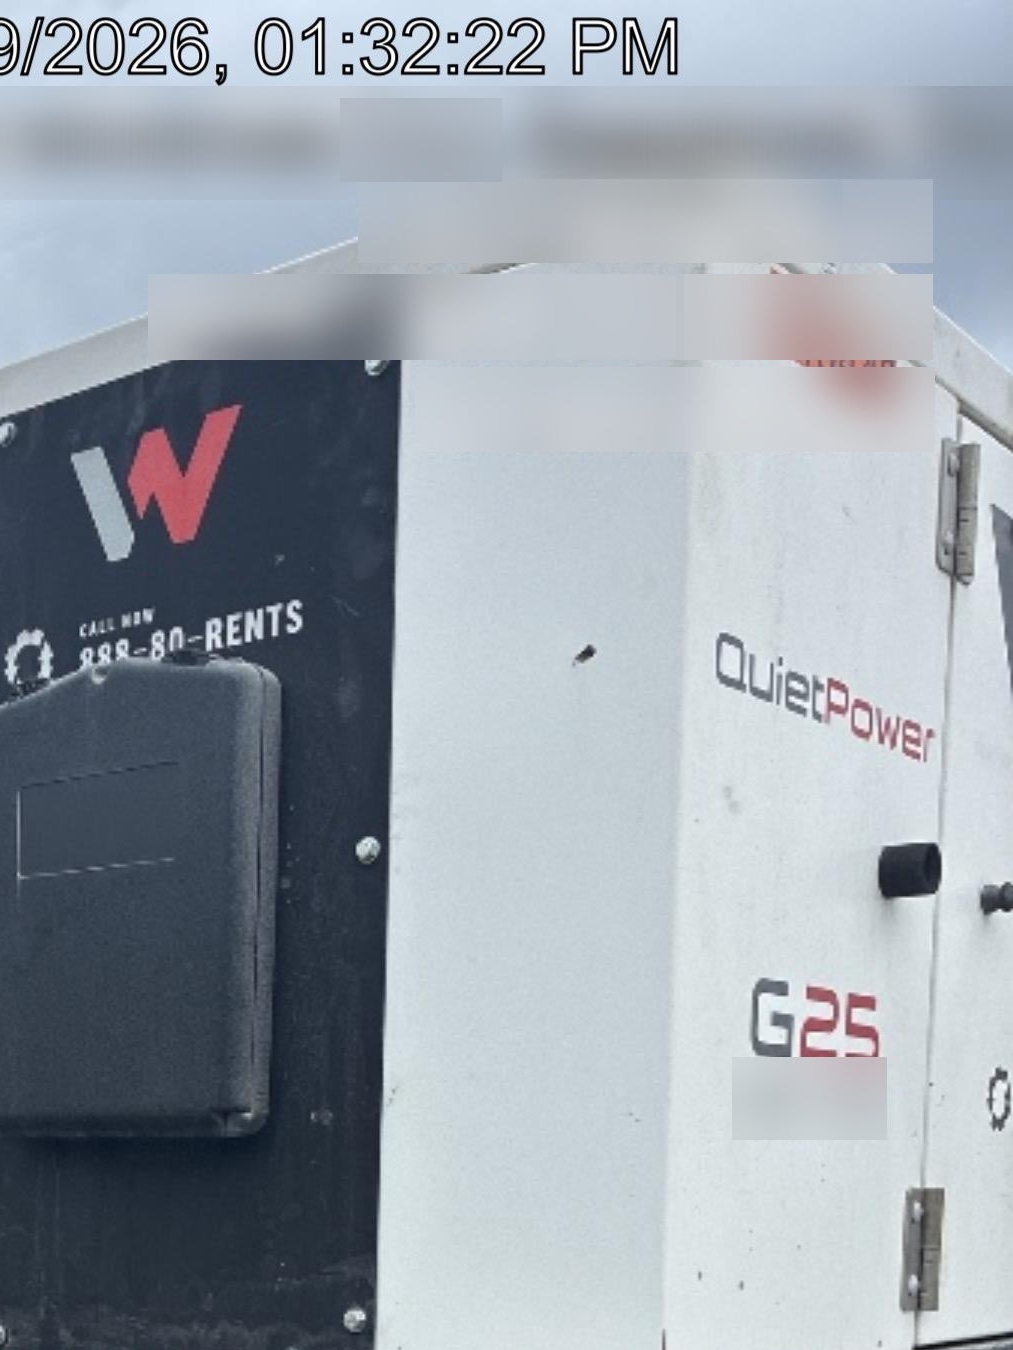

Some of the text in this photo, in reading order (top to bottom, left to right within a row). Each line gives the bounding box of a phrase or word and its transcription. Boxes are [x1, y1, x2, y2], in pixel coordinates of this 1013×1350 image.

[79, 606, 156, 639] CALL NOW
[715, 632, 936, 763] QuietPower
[751, 978, 880, 1057] G25
